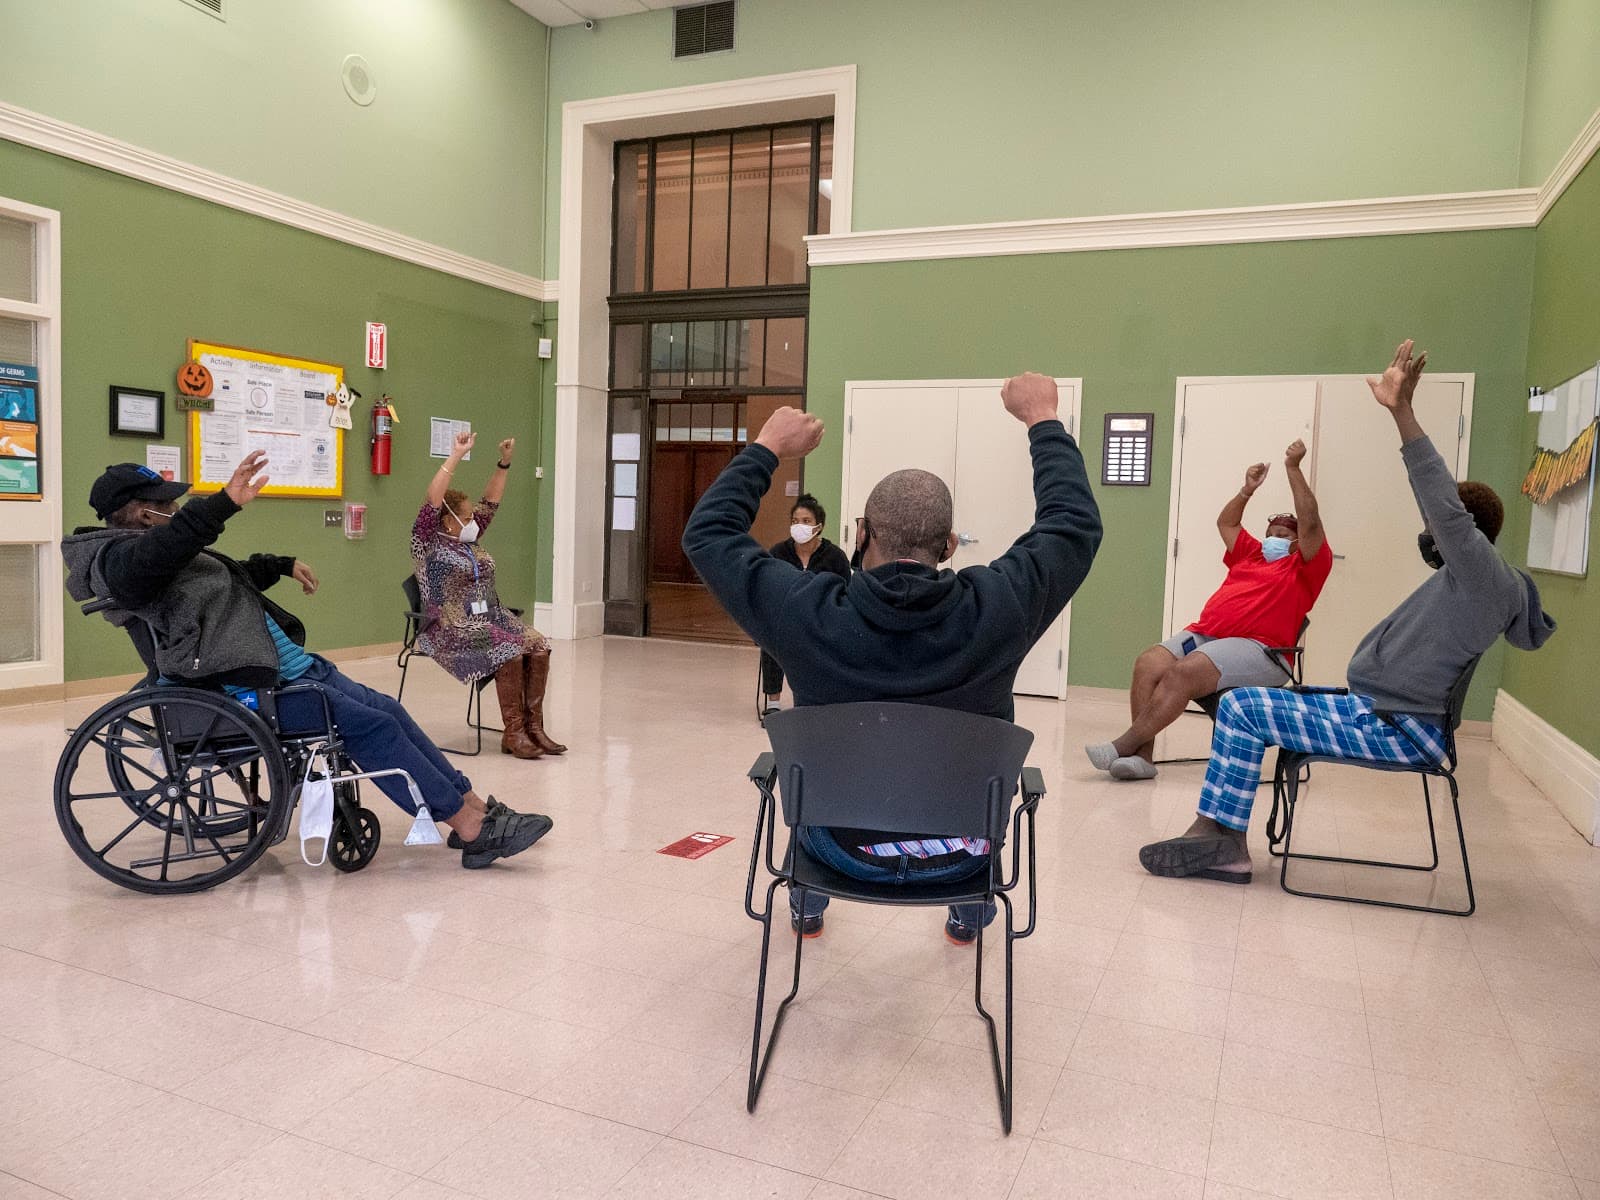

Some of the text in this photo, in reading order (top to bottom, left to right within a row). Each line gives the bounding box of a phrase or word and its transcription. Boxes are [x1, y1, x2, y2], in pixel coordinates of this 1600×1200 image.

[6, 368, 25, 377] GERMS
[210, 357, 316, 379] Activity Information Board
[257, 409, 274, 417] Person
